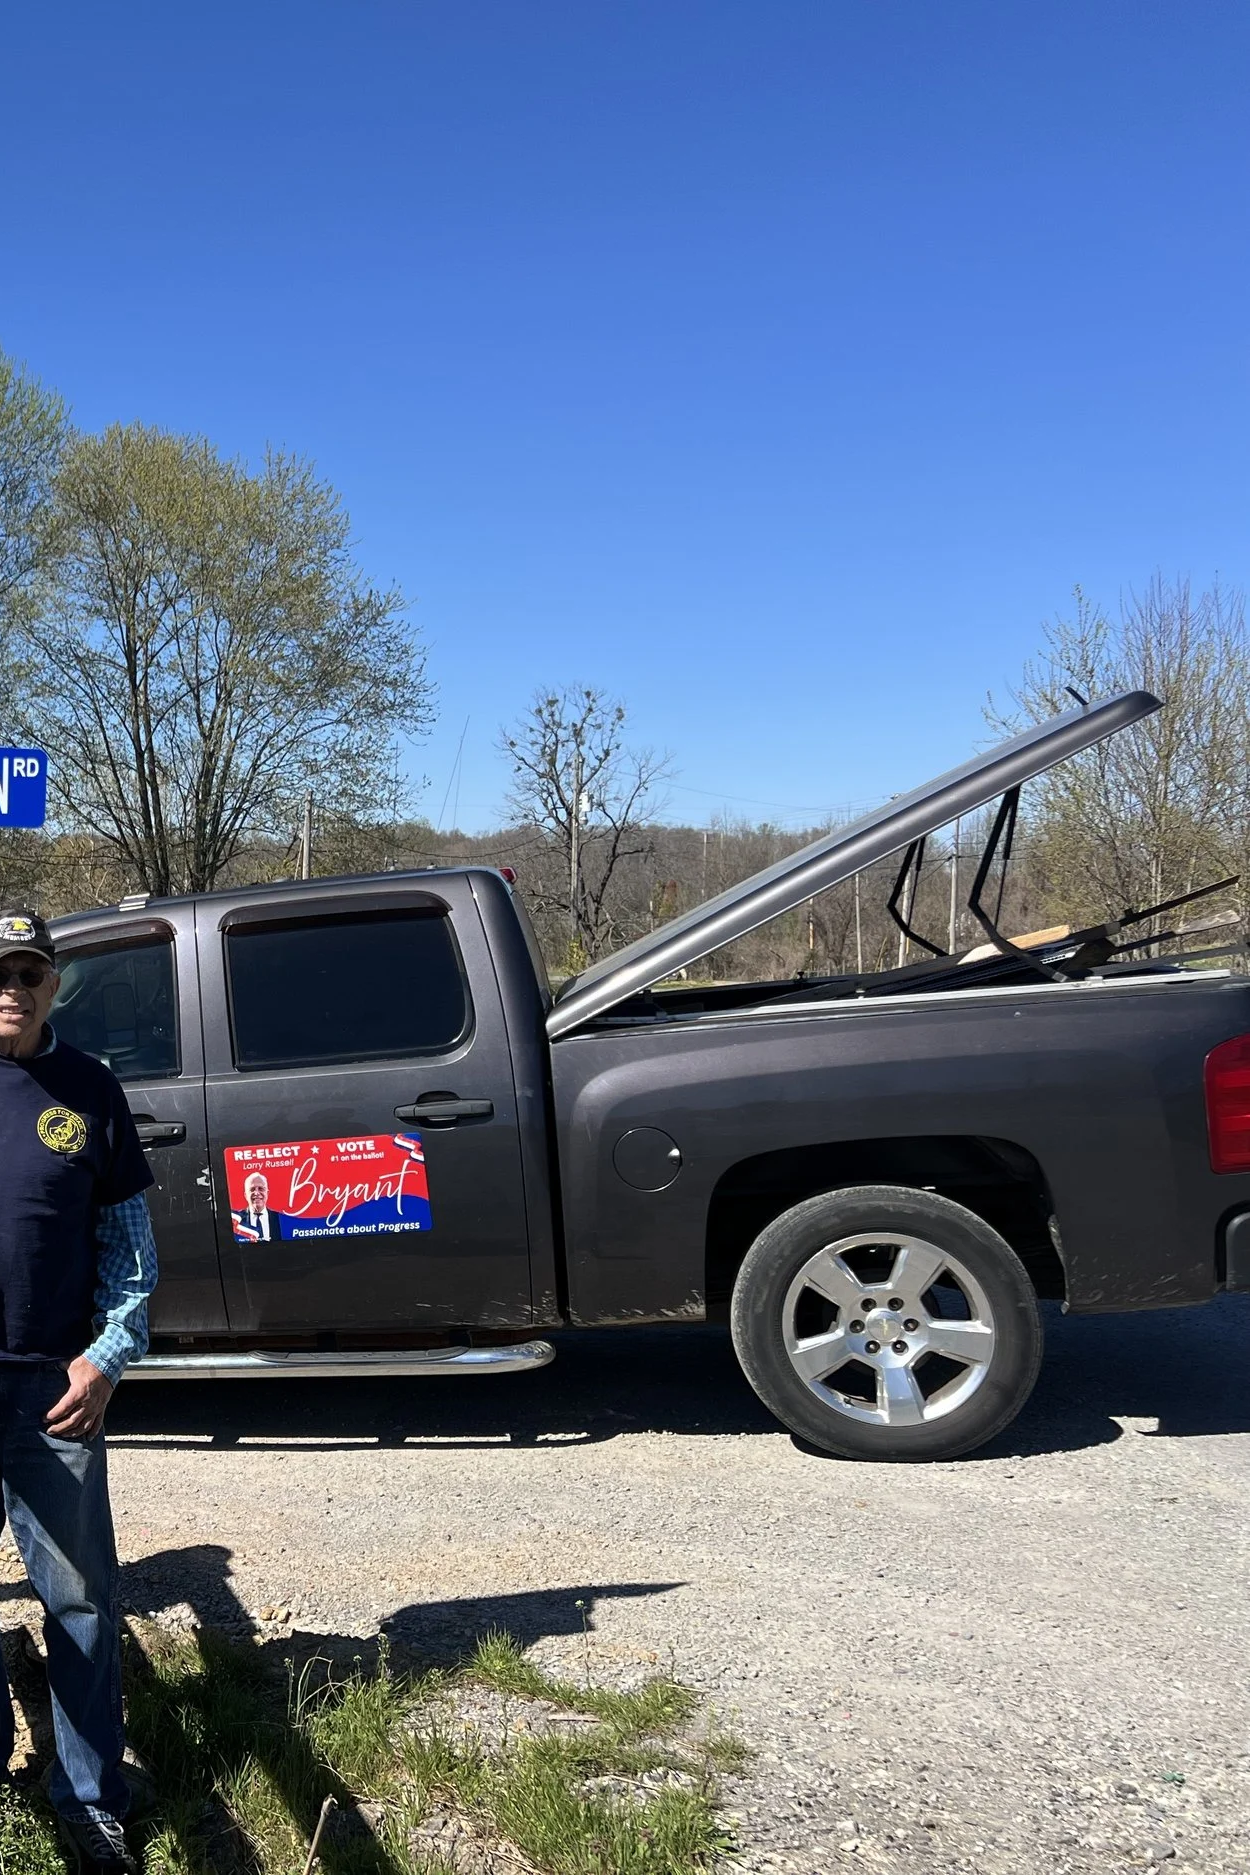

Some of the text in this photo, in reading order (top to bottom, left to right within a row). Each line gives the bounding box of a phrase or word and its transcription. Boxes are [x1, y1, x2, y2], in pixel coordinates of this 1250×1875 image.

[13, 758, 40, 778] RD
[234, 1140, 376, 1161] RE-ELECT VOTE
[350, 1153, 362, 1161] the
[243, 1159, 295, 1170] Larry Russell
[282, 1157, 418, 1227] Bryant
[292, 1221, 421, 1238] Passionate about Progress
